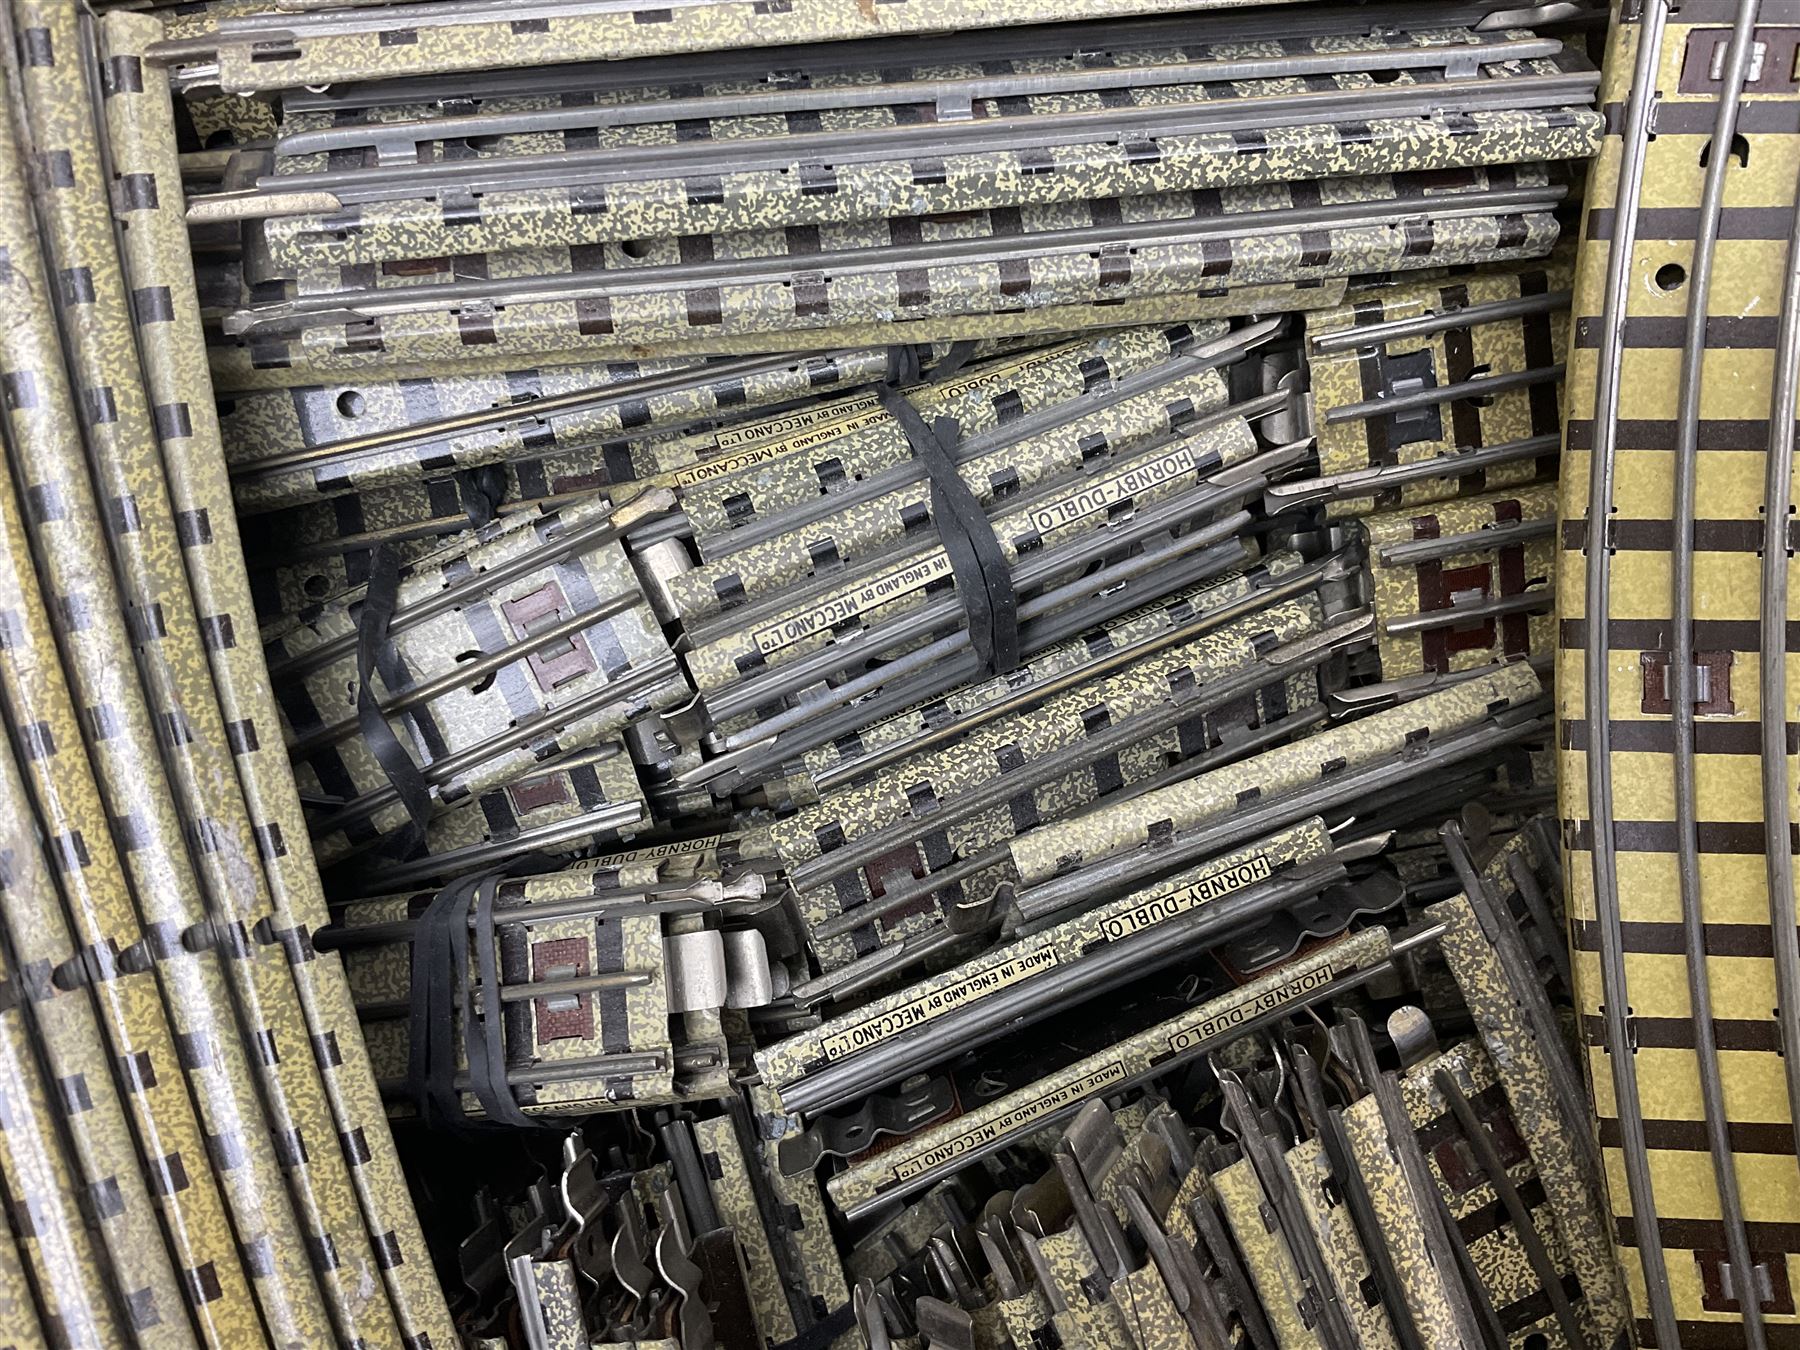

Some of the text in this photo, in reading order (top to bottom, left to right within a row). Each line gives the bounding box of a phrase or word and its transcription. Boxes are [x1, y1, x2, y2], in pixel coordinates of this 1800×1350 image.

[816, 410, 830, 421] BY
[746, 415, 814, 440] MECCANO
[793, 427, 842, 448] ENGLAND
[847, 422, 859, 432] IN
[774, 443, 788, 454] BY
[696, 447, 774, 481] MECCANO
[1037, 451, 1192, 530] HORNBY-DUBLO
[934, 556, 948, 572] IN
[878, 564, 932, 596] ENGLAND
[860, 589, 875, 604] BY
[784, 598, 859, 639] MECCANO
[575, 836, 717, 869] HORNBY-DUBLO
[1107, 859, 1268, 938] HORNBY-DUBLO
[1019, 949, 1052, 971] MADE
[1002, 966, 1015, 979] IN
[943, 973, 1000, 1003] ENGLAND
[928, 997, 943, 1011] BY
[1176, 969, 1329, 1049] HORNBY-DUBLO
[852, 1004, 926, 1046] MECCANO
[1088, 1066, 1121, 1087] MADE
[1071, 1084, 1085, 1097] IN
[521, 1101, 584, 1115] ECCANO
[1016, 1090, 1069, 1121] ENGLAND
[998, 1116, 1013, 1131] BY
[924, 1128, 997, 1166] MECCANO
